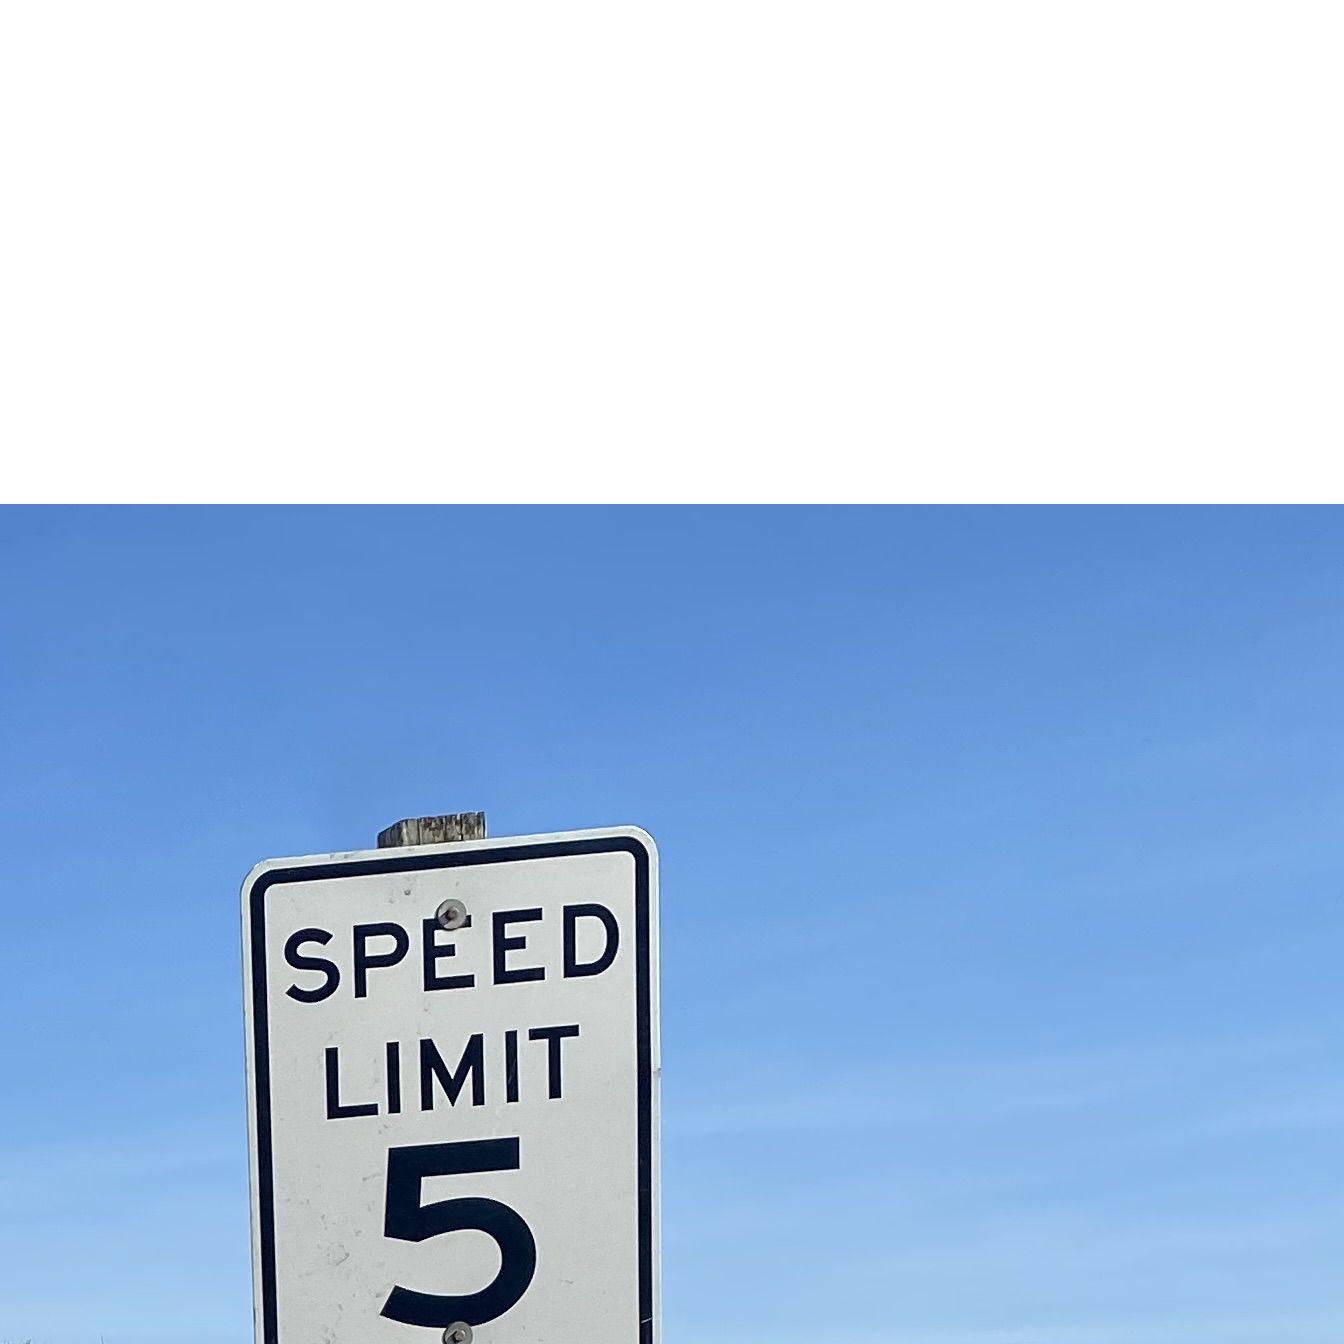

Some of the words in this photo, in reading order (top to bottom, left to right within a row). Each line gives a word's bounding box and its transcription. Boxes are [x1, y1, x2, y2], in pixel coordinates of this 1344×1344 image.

[283, 902, 620, 1004] SPEED
[325, 1024, 580, 1120] LIMIT
[379, 1136, 537, 1329] 5
